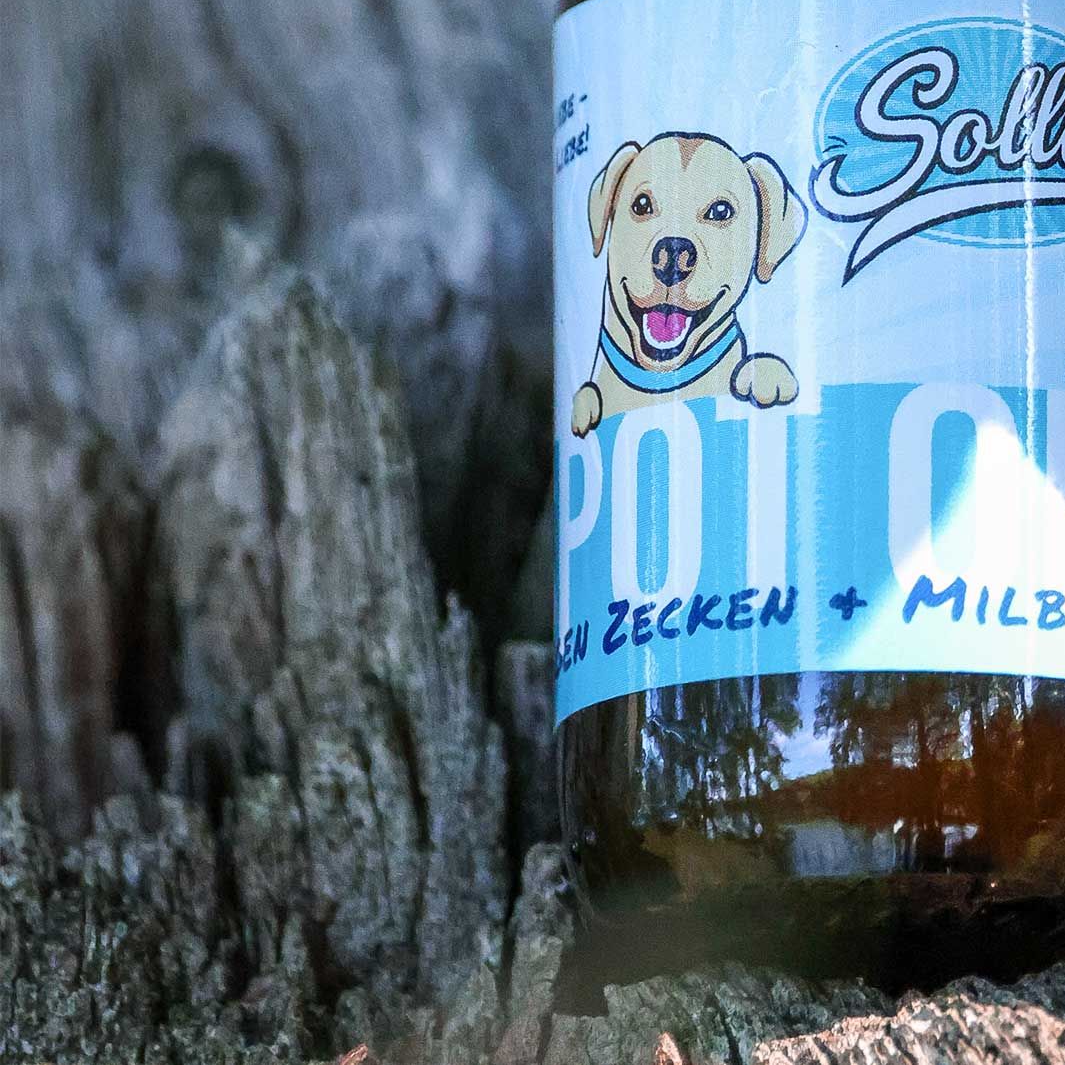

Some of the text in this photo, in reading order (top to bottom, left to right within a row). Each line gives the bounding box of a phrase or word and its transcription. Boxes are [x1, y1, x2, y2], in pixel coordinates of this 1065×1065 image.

[557, 93, 575, 129] BE
[602, 585, 798, 655] ZECKEN
[828, 585, 868, 621] +
